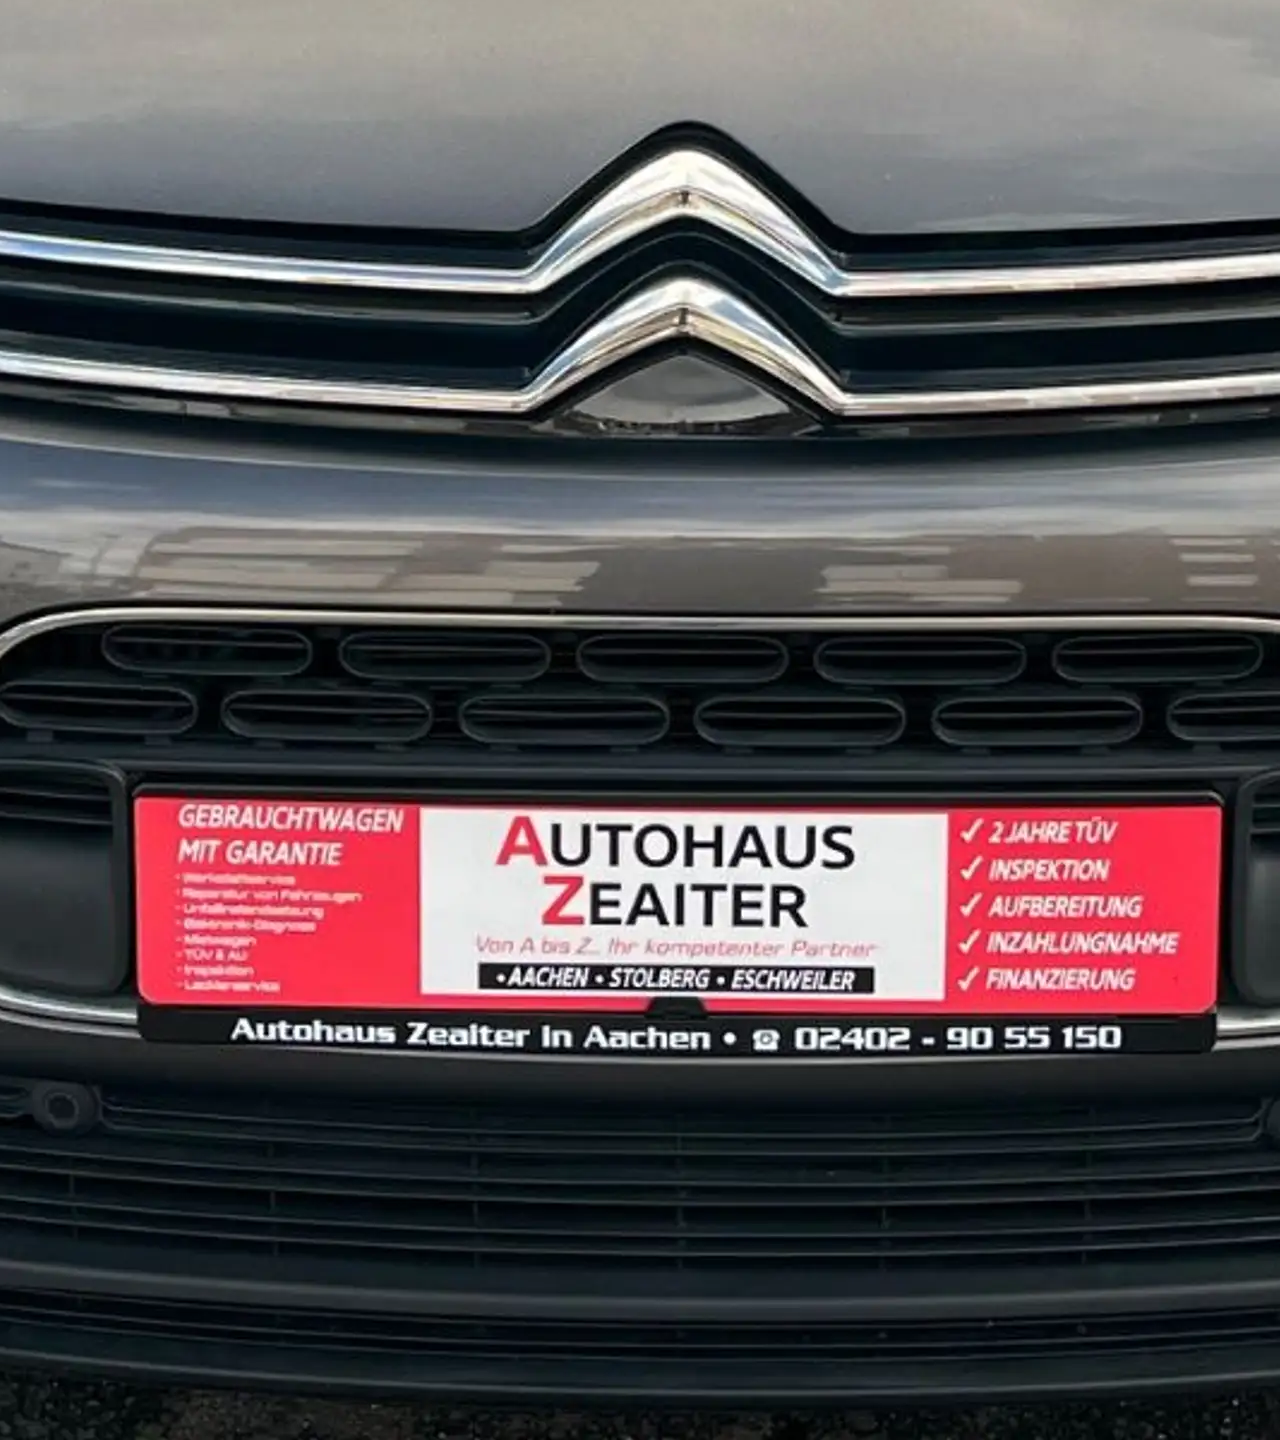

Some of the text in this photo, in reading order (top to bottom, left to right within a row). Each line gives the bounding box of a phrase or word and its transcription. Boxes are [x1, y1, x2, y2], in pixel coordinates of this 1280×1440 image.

[178, 803, 404, 833] GEBRAUCHTWAGEN
[988, 817, 1118, 844] 2 JAHRE TÜV
[178, 839, 343, 866] MIT GARANTIE
[496, 816, 855, 869] AUTOHAUS
[988, 859, 1110, 881] INSPEKTION
[541, 876, 808, 928] ZEAITER
[988, 896, 1143, 918] AUFBEREITUNG
[476, 934, 514, 953] Von
[520, 937, 535, 953] A
[541, 939, 569, 954] bis
[608, 936, 638, 955] Ihr
[645, 937, 784, 958] kompetenter
[791, 940, 880, 958] Partner
[986, 932, 1180, 954] INZAHLUNGNAHME
[507, 967, 856, 991] AACHEN STOLBERG ESCHWEILER
[985, 968, 1136, 991] FINANZIERUNG
[231, 1018, 396, 1044] Autohaus
[583, 1025, 712, 1050] Aachen
[795, 1027, 910, 1051] 02402
[947, 1027, 993, 1050] 90
[1004, 1027, 1050, 1050] 55
[1061, 1026, 1122, 1050] 150
